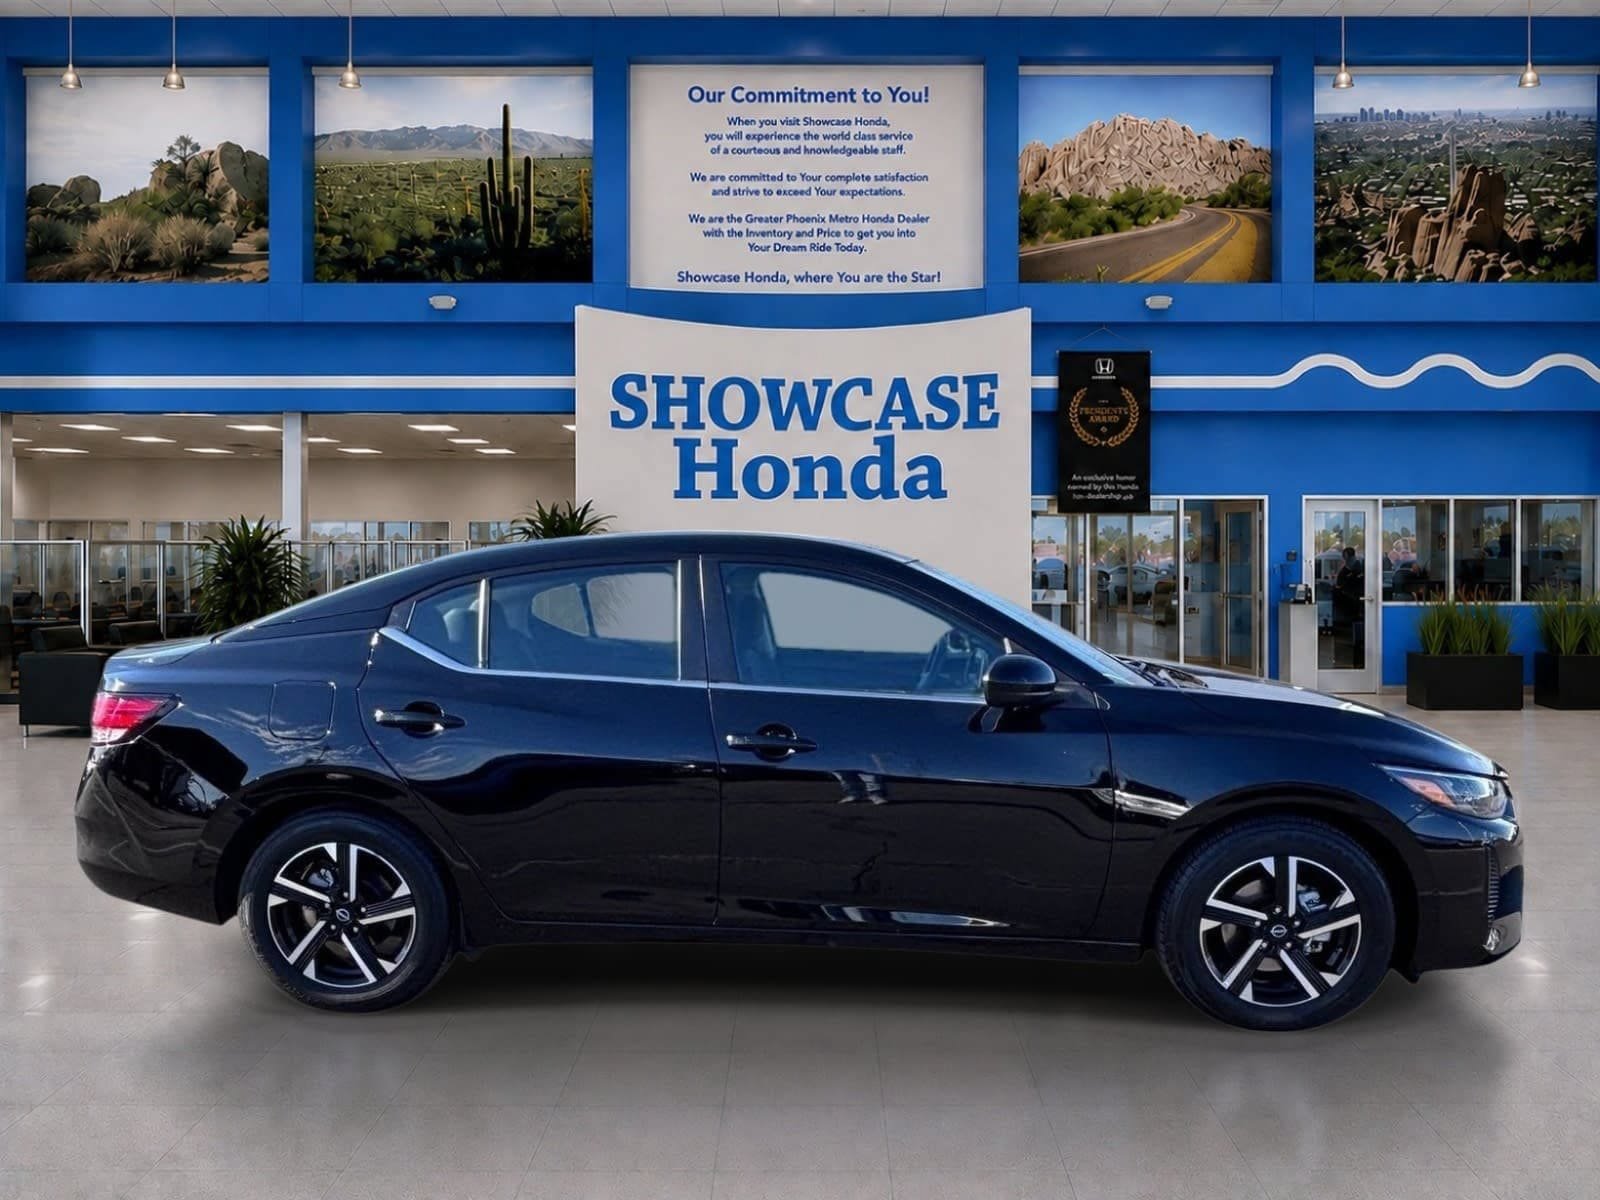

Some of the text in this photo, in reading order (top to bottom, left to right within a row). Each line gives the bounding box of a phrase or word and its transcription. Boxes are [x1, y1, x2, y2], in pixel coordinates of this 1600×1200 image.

[688, 85, 929, 104] Our Commitment to You!
[726, 116, 891, 129] When you visit Showcase Honda,
[704, 130, 913, 143] you will experience the world class service
[710, 144, 721, 155] of
[722, 147, 729, 155] a
[731, 146, 781, 155] courteous
[782, 145, 802, 155] and
[881, 144, 906, 155] staff.
[690, 172, 707, 182] We
[728, 172, 784, 182] committed
[786, 173, 797, 182] to
[799, 172, 822, 182] Your
[824, 172, 872, 185] complete
[873, 172, 929, 182] satisfaction
[711, 186, 905, 200] and strive to exceed Your expectations.
[688, 213, 930, 224] We are the Greater Phoenix Metro Honda Dealer
[702, 227, 916, 241] with the Inventory and Price to get you into
[747, 242, 867, 255] Your Dream Ride Today.
[677, 270, 941, 285] Showcase Honda, where You are the Star!
[609, 372, 1001, 432] SHOWCASE
[672, 434, 948, 500] Honda
